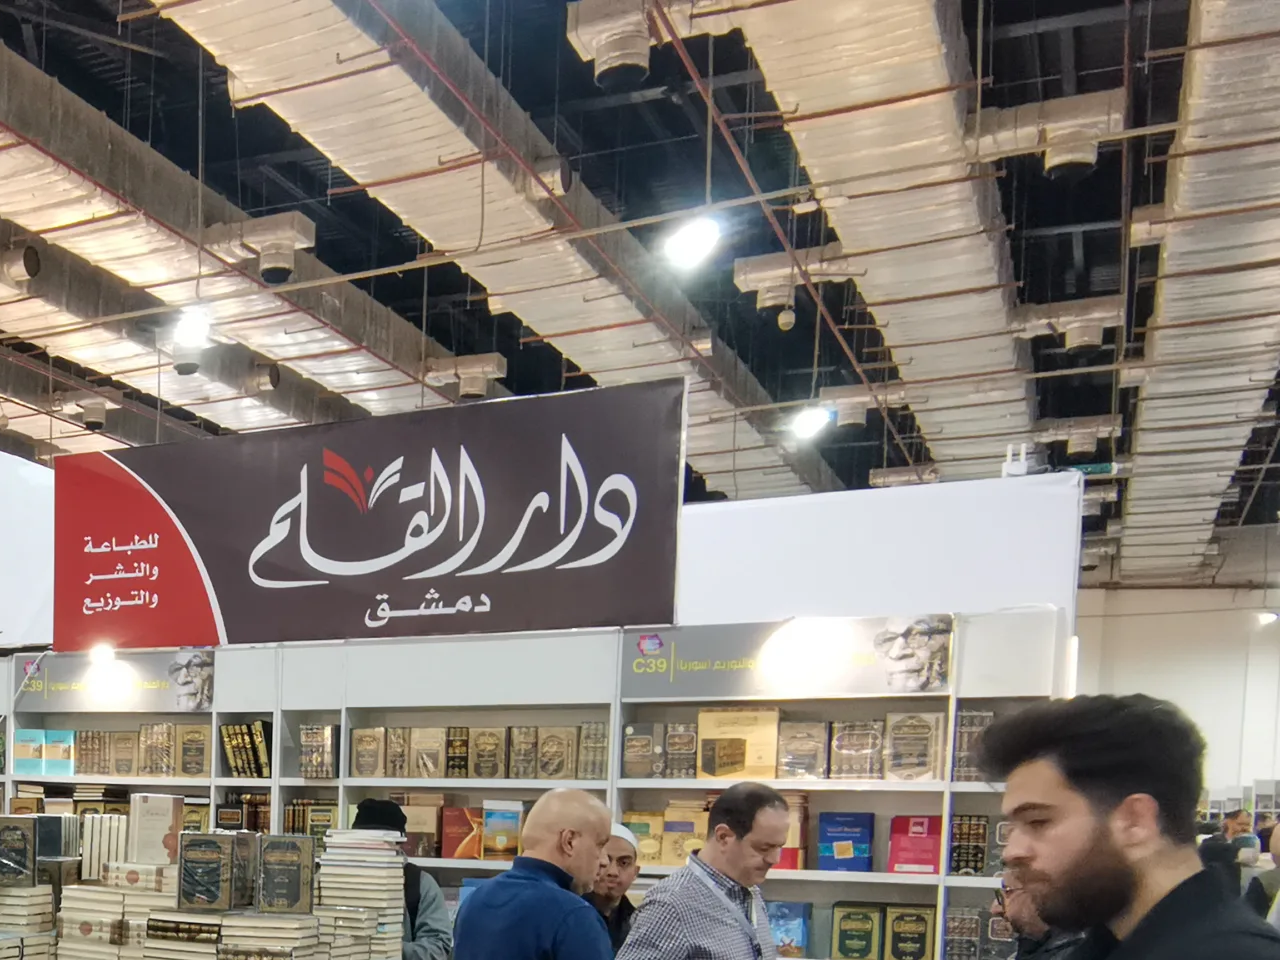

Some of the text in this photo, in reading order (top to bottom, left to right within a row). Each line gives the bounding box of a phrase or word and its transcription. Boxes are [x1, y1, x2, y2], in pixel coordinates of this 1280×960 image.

[248, 433, 637, 590] دار القلم
[83, 532, 159, 555] للطباعة
[84, 562, 159, 585] والنشر
[82, 589, 159, 615] والتوزيع
[364, 588, 491, 628] دمشق
[632, 658, 667, 673] C39
